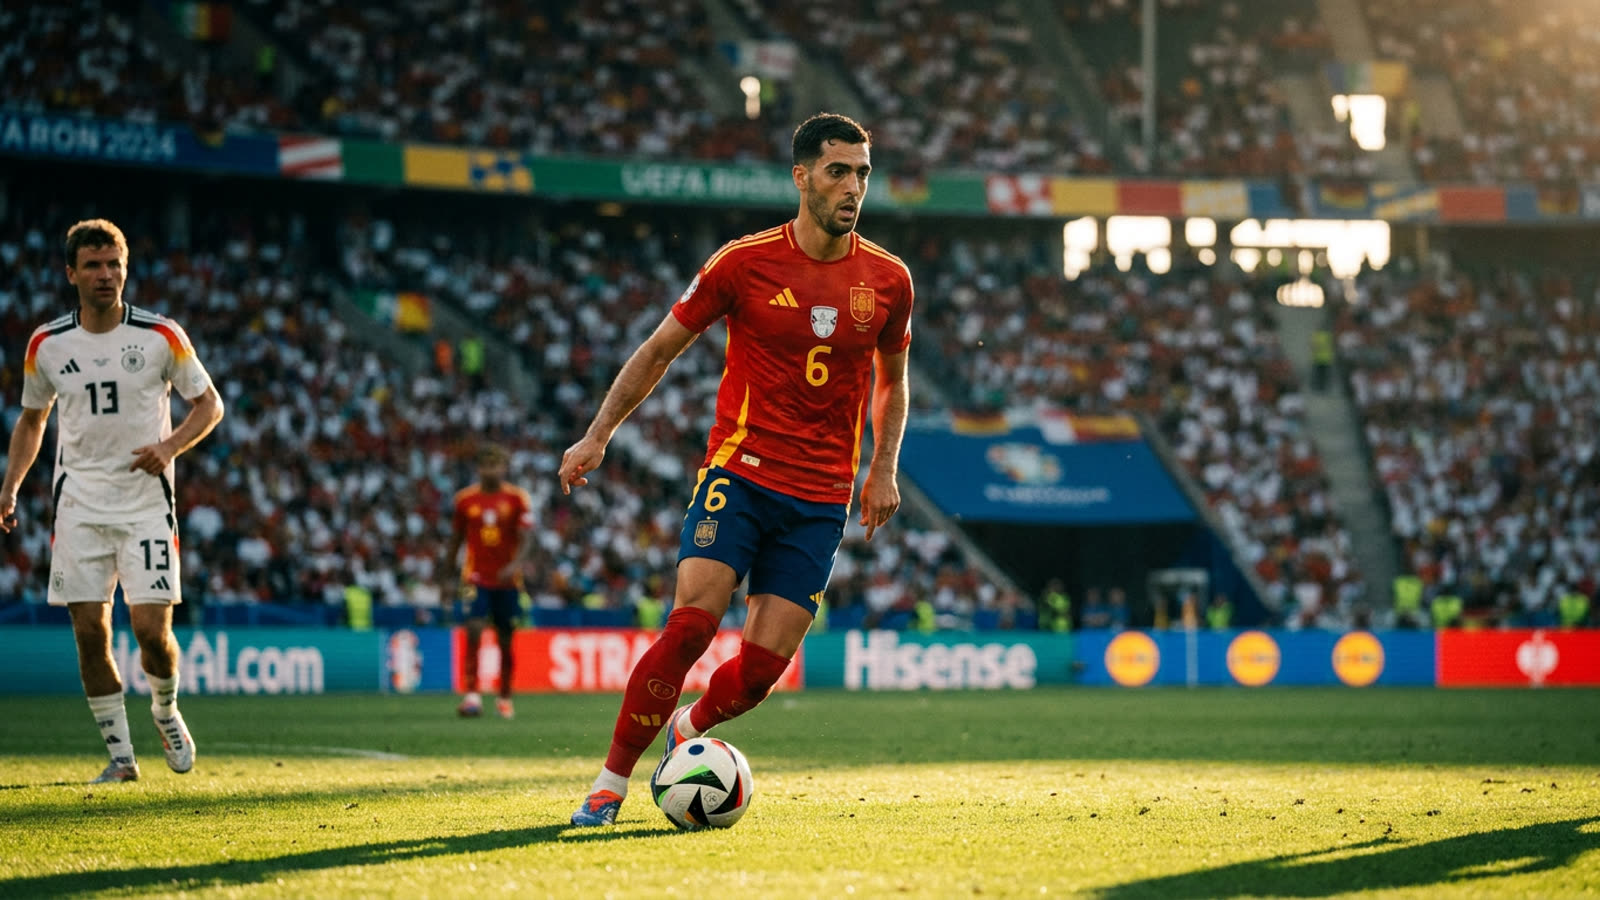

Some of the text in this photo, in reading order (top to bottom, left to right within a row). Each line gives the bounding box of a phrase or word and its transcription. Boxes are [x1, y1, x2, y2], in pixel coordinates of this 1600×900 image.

[806, 345, 832, 387] 6
[85, 381, 119, 415] 13
[704, 478, 730, 512] 6
[140, 539, 170, 570] 13
[844, 629, 1037, 690] Hisense
